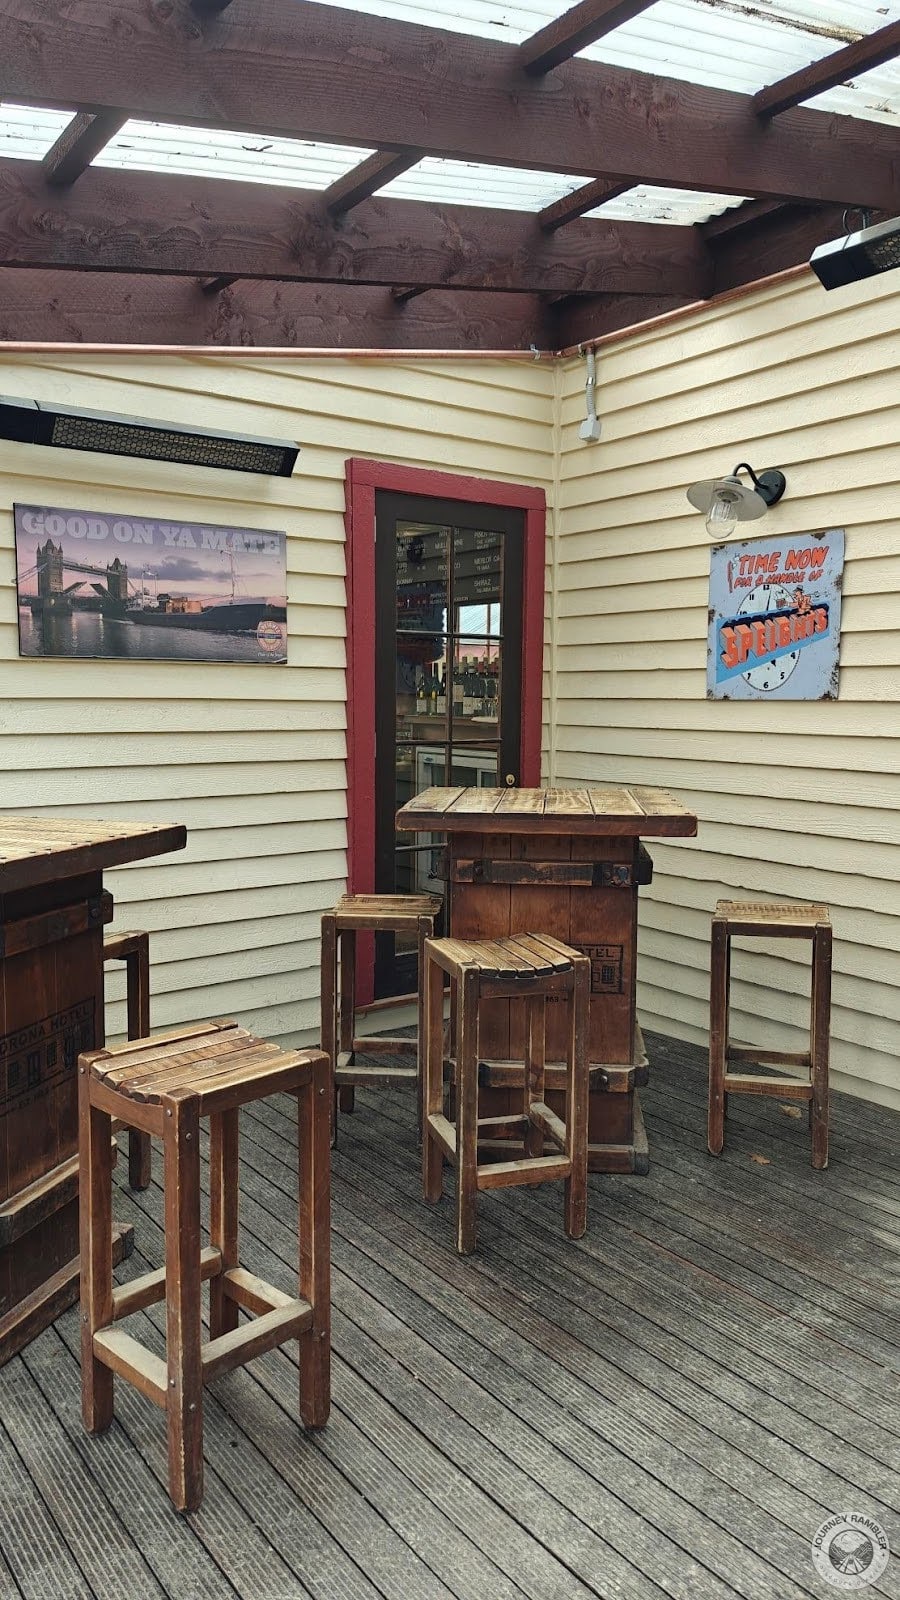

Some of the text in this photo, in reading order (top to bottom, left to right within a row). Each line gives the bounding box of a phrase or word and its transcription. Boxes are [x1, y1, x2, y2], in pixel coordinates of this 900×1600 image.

[22, 511, 280, 556] GOOD ON YA MATE
[739, 545, 830, 576] TIME NOW
[474, 579, 491, 587] SHIRAZ
[734, 568, 824, 589] FOR A HANDLE OF
[720, 608, 828, 669] SPEIGHTS
[790, 652, 796, 660] 4
[747, 672, 752, 680] 7
[780, 672, 785, 680] 5
[763, 681, 769, 689] 6
[50, 1004, 90, 1031] HOTEL
